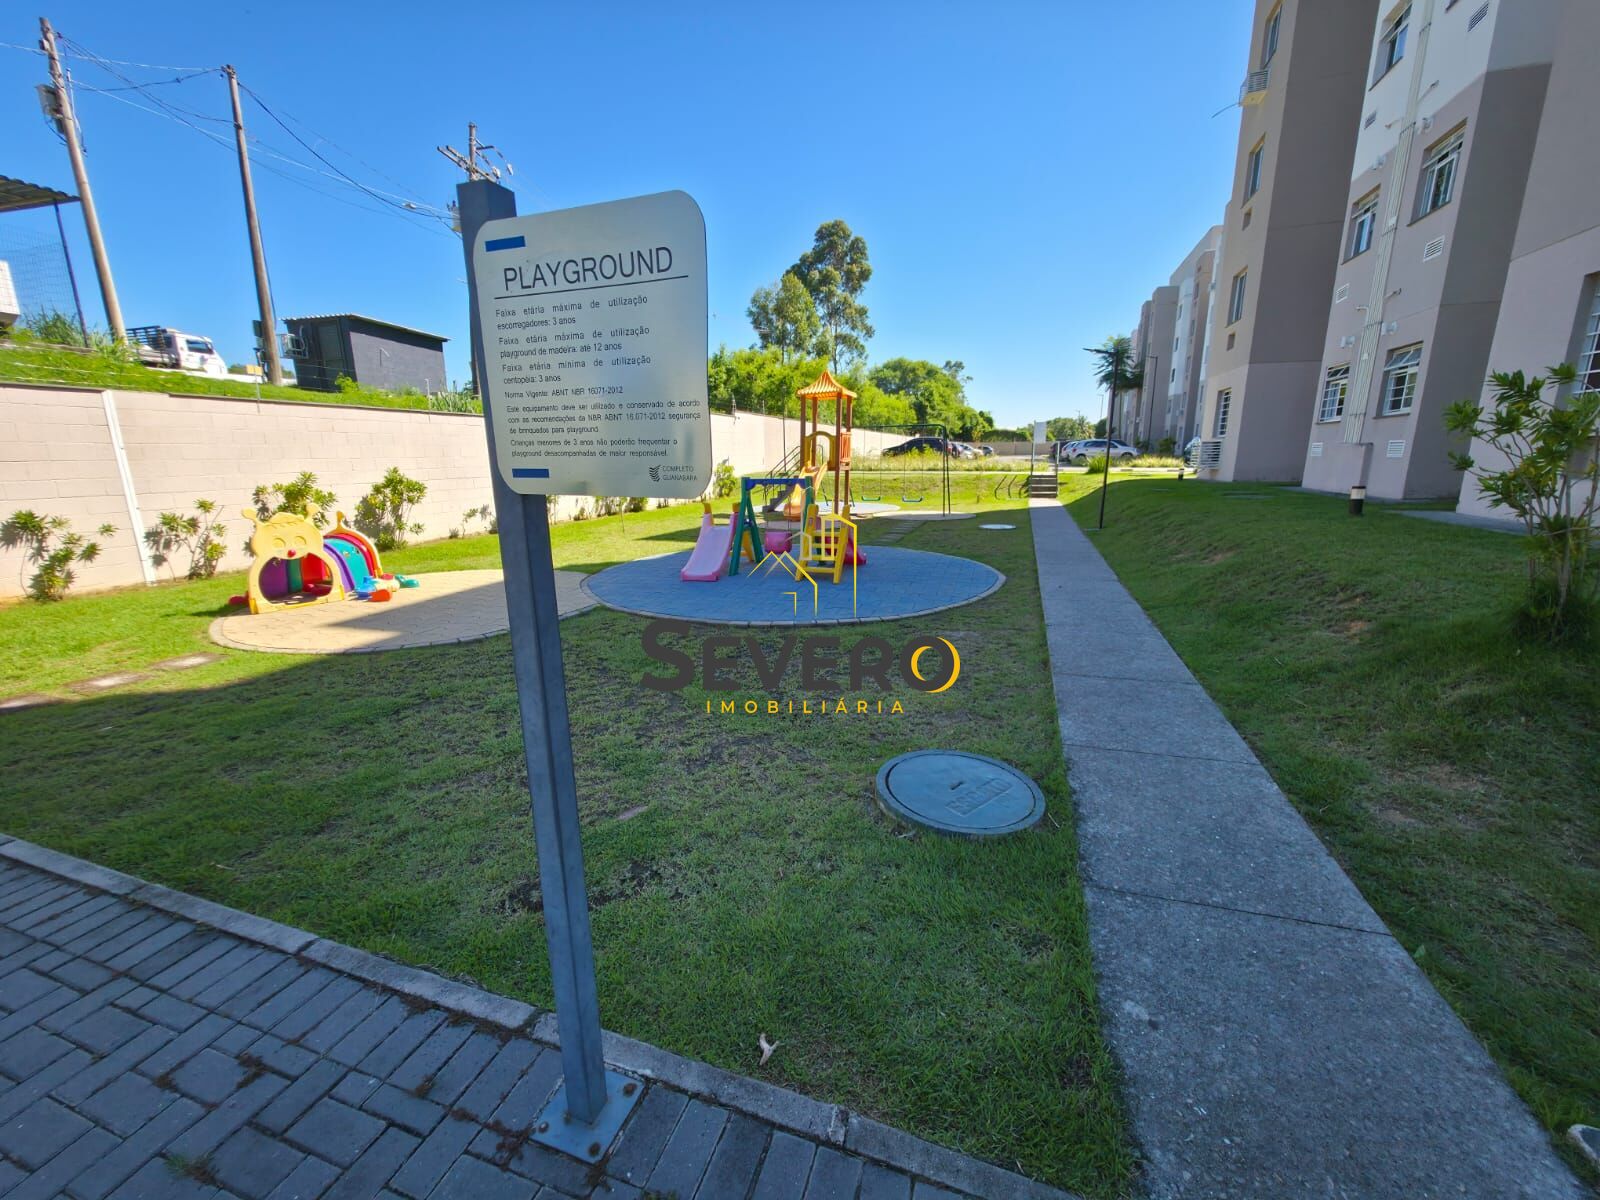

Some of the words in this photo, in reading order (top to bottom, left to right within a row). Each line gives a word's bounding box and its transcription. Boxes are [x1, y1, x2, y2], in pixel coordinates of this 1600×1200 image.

[504, 247, 673, 291] PLAYGROUND
[496, 308, 516, 317] Faixa
[552, 302, 582, 312] máxima
[590, 300, 600, 309] de
[608, 295, 648, 307] utilização
[552, 317, 557, 325] 3
[559, 317, 576, 325] anos
[499, 337, 519, 345] Faixa
[526, 334, 547, 343] etária
[555, 331, 585, 341] máxima
[593, 329, 602, 338] de
[610, 326, 650, 337] utilização
[500, 347, 537, 359] playground
[538, 346, 547, 355] de
[580, 344, 591, 352] até
[594, 342, 602, 351] 12
[604, 342, 622, 351] anos
[502, 363, 522, 372] Faixa
[529, 361, 551, 370] etária
[558, 358, 586, 369] mínima
[594, 358, 603, 366] de
[611, 355, 651, 366] utilização
[538, 374, 543, 382] 3
[504, 391, 524, 399] Norma
[551, 388, 568, 397] ABNT
[572, 387, 585, 396] NBR
[588, 385, 624, 395] 16071-2012
[590, 401, 615, 409] utilizado
[626, 400, 664, 409] conservado
[667, 399, 676, 407] de
[678, 399, 701, 407] acordo
[588, 412, 602, 421] NBR
[604, 411, 623, 420] ABNT
[668, 410, 701, 421] segurança
[552, 426, 565, 434] para
[564, 438, 571, 446] de
[573, 438, 577, 446] 3
[579, 438, 594, 446] anos
[597, 438, 608, 446] não
[512, 450, 542, 458] playground
